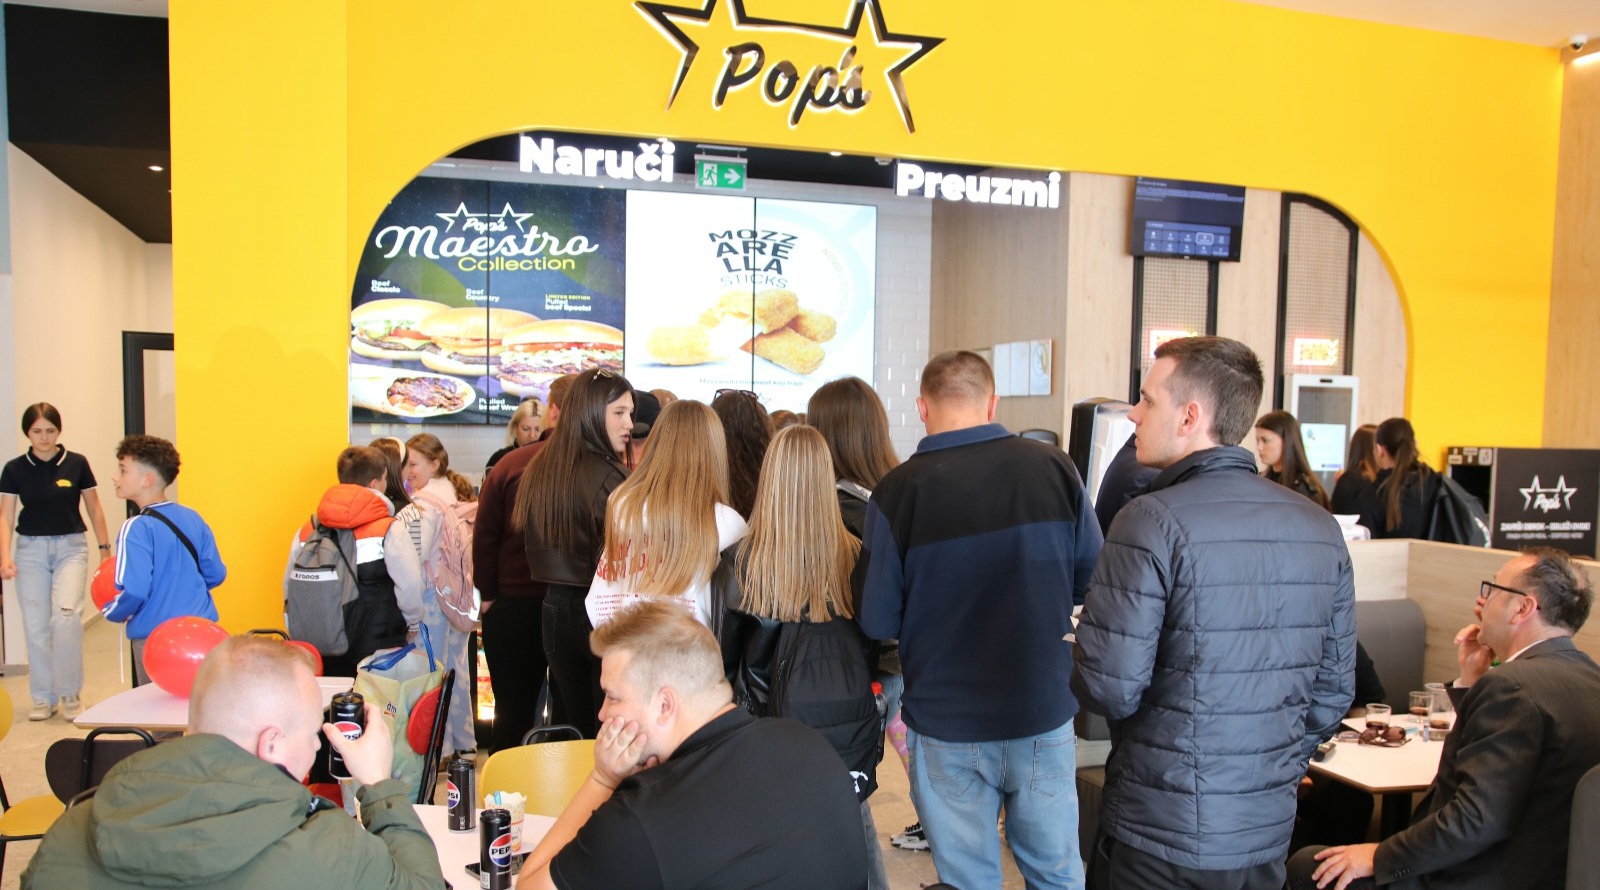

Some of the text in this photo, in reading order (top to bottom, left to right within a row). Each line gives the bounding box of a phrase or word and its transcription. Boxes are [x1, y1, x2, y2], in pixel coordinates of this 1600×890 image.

[712, 41, 872, 128] Pop's
[519, 136, 676, 183] Naruči
[896, 162, 1061, 209] Preuzmi
[462, 217, 507, 234] Pop's
[375, 225, 599, 260] Maestro
[708, 229, 799, 246] MOZZ
[716, 240, 795, 260] ARE
[458, 256, 576, 272] Collection
[722, 255, 784, 275] LLA
[371, 280, 390, 288] Beef
[720, 273, 789, 289] STICKS
[371, 286, 401, 294] Classic
[466, 288, 485, 296] Beef
[466, 294, 500, 302] Country
